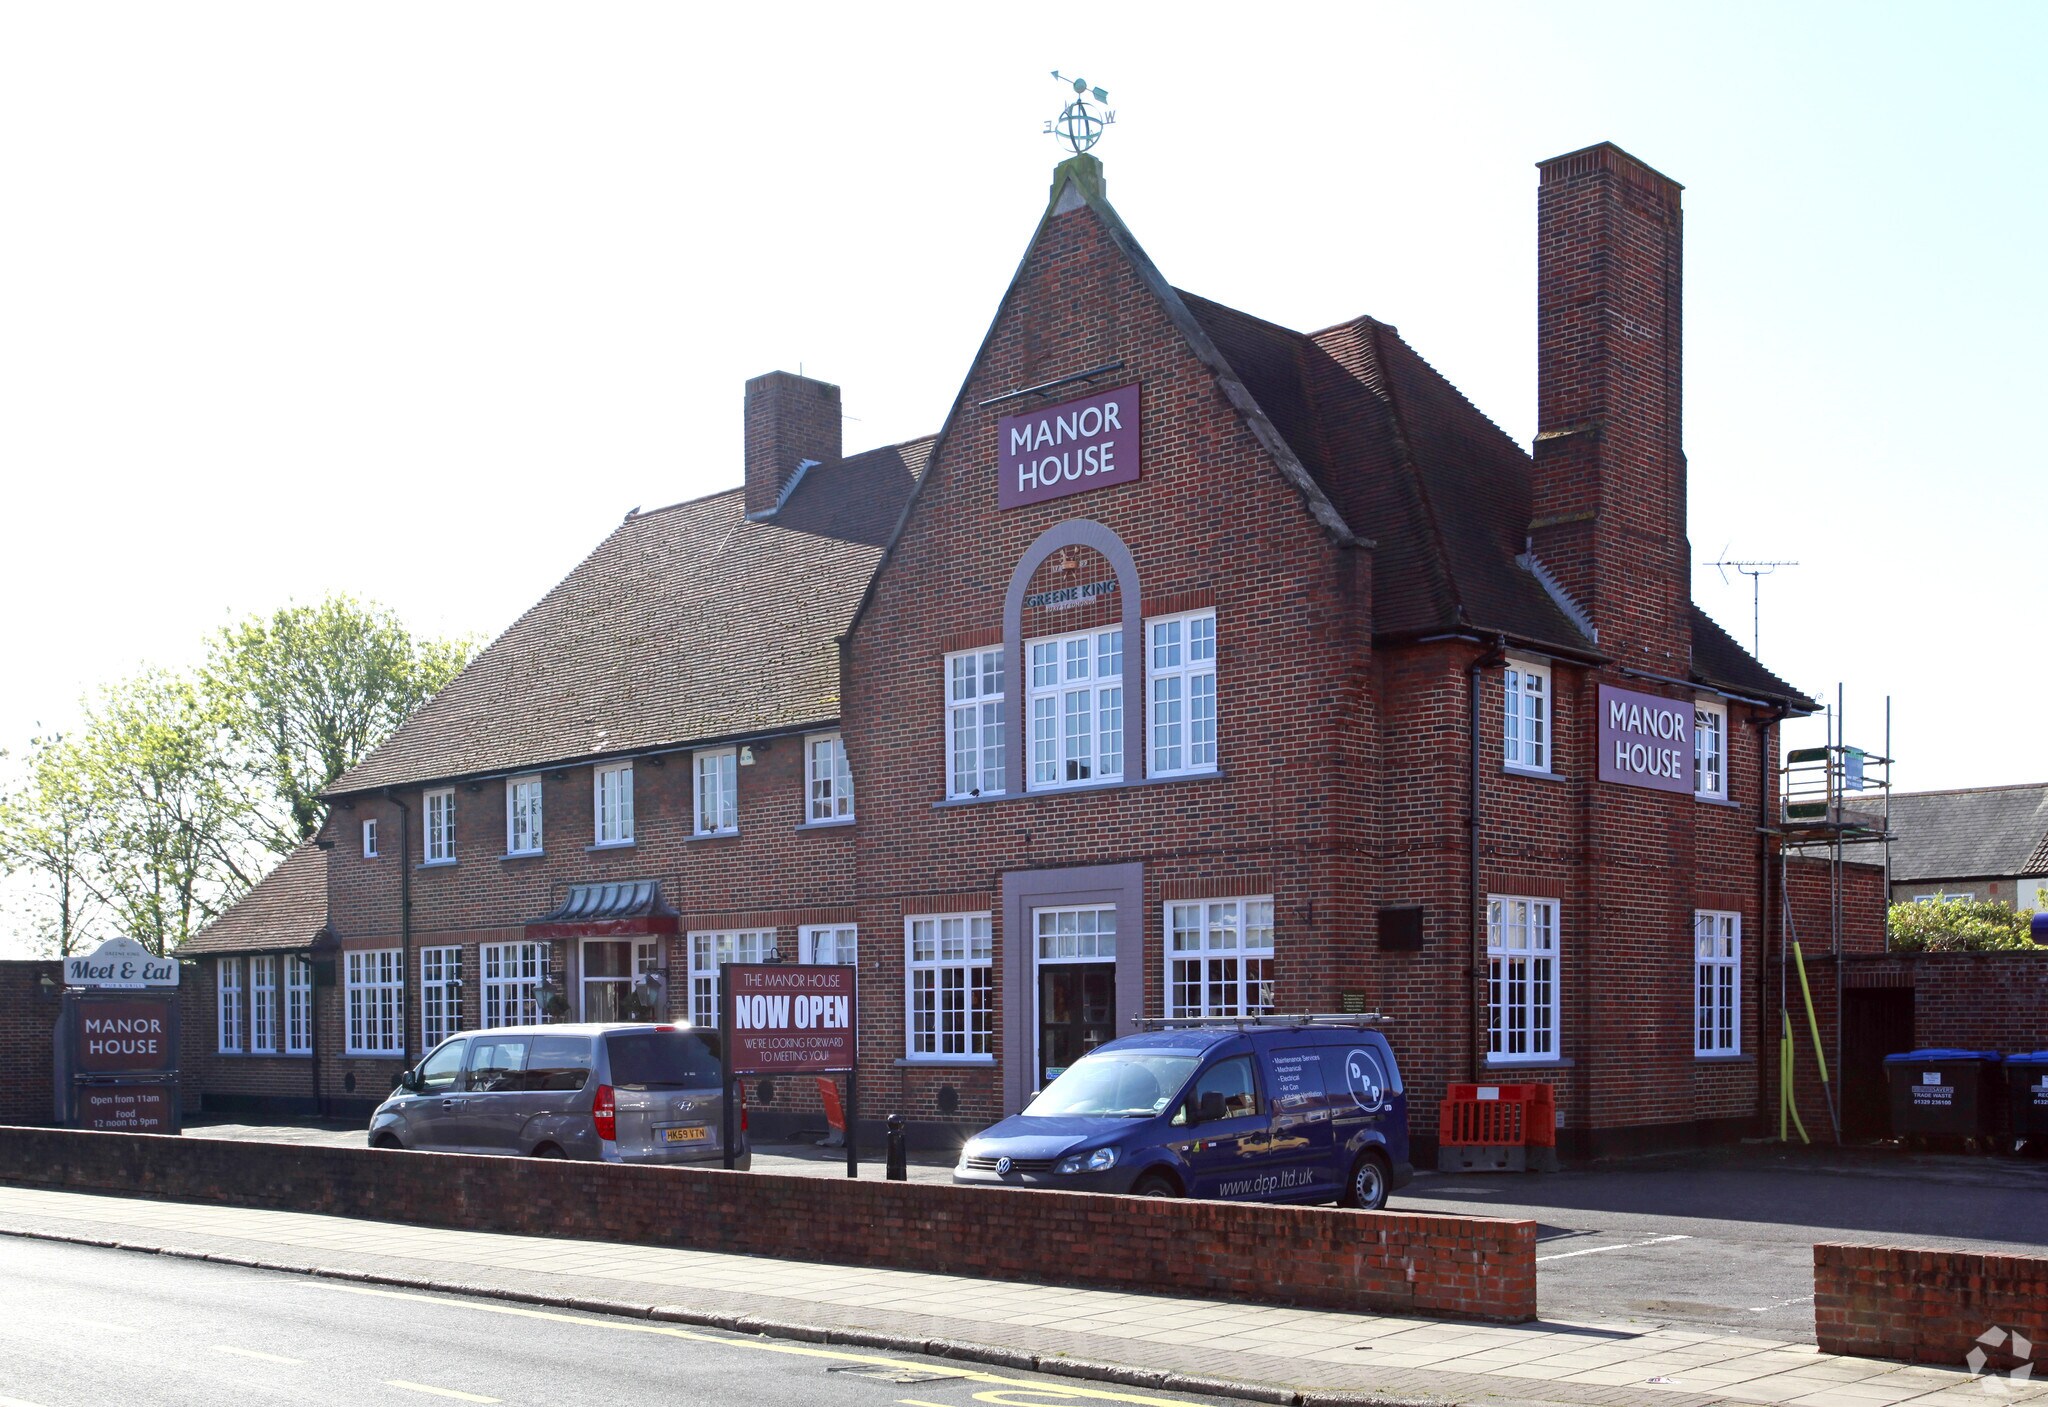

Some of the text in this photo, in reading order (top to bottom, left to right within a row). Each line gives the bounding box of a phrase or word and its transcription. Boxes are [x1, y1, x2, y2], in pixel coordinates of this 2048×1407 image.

[1011, 402, 1122, 456] MANOR
[1018, 441, 1115, 492] HOUSE
[1027, 580, 1117, 608] GREENE KING
[1609, 699, 1686, 742] MANOR
[1615, 740, 1681, 779] HOUSE
[70, 961, 172, 980] Meet & Eat
[744, 973, 841, 988] THE MANOR HOUSE
[735, 994, 849, 1030] NOW OPEN
[85, 1019, 162, 1034] MANOR
[89, 1040, 158, 1055] HOUSE
[744, 1036, 844, 1050] WE'RE LOOKING FORWARD
[760, 1051, 773, 1062] TO
[773, 1050, 808, 1062] MEETING
[1302, 1054, 1321, 1062] Services
[1276, 1065, 1302, 1073] Mechanical
[1280, 1074, 1300, 1082] Electrical
[90, 1094, 160, 1106] Open from 11am
[115, 1109, 136, 1118] Food
[93, 1117, 159, 1128] 12 noon to 9pm
[667, 1129, 705, 1140] HK59 VTN
[1219, 1170, 1313, 1196] www.dpp.ltd.uk
